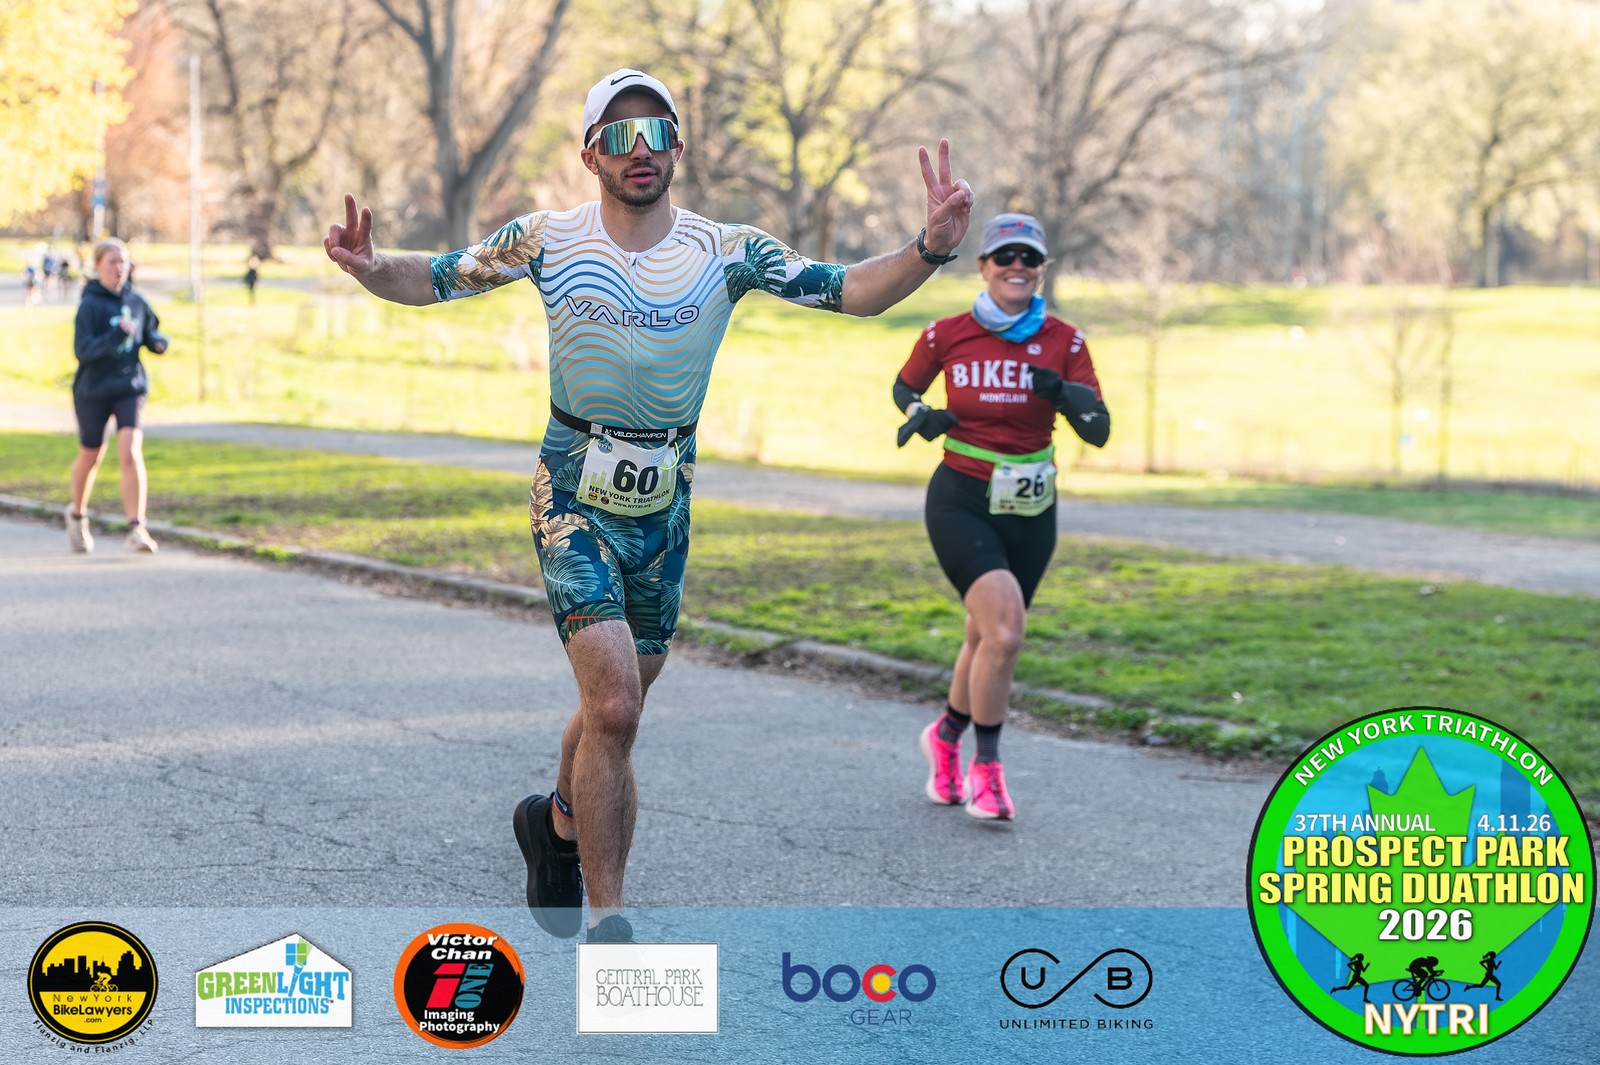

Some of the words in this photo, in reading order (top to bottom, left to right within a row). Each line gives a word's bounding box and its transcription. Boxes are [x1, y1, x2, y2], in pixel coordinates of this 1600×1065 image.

[564, 294, 700, 327] VARLO
[613, 459, 659, 495] 60
[1016, 474, 1045, 498] 26
[588, 485, 607, 496] NEW
[609, 491, 631, 503] YORK
[633, 489, 670, 504] TRIATHLON
